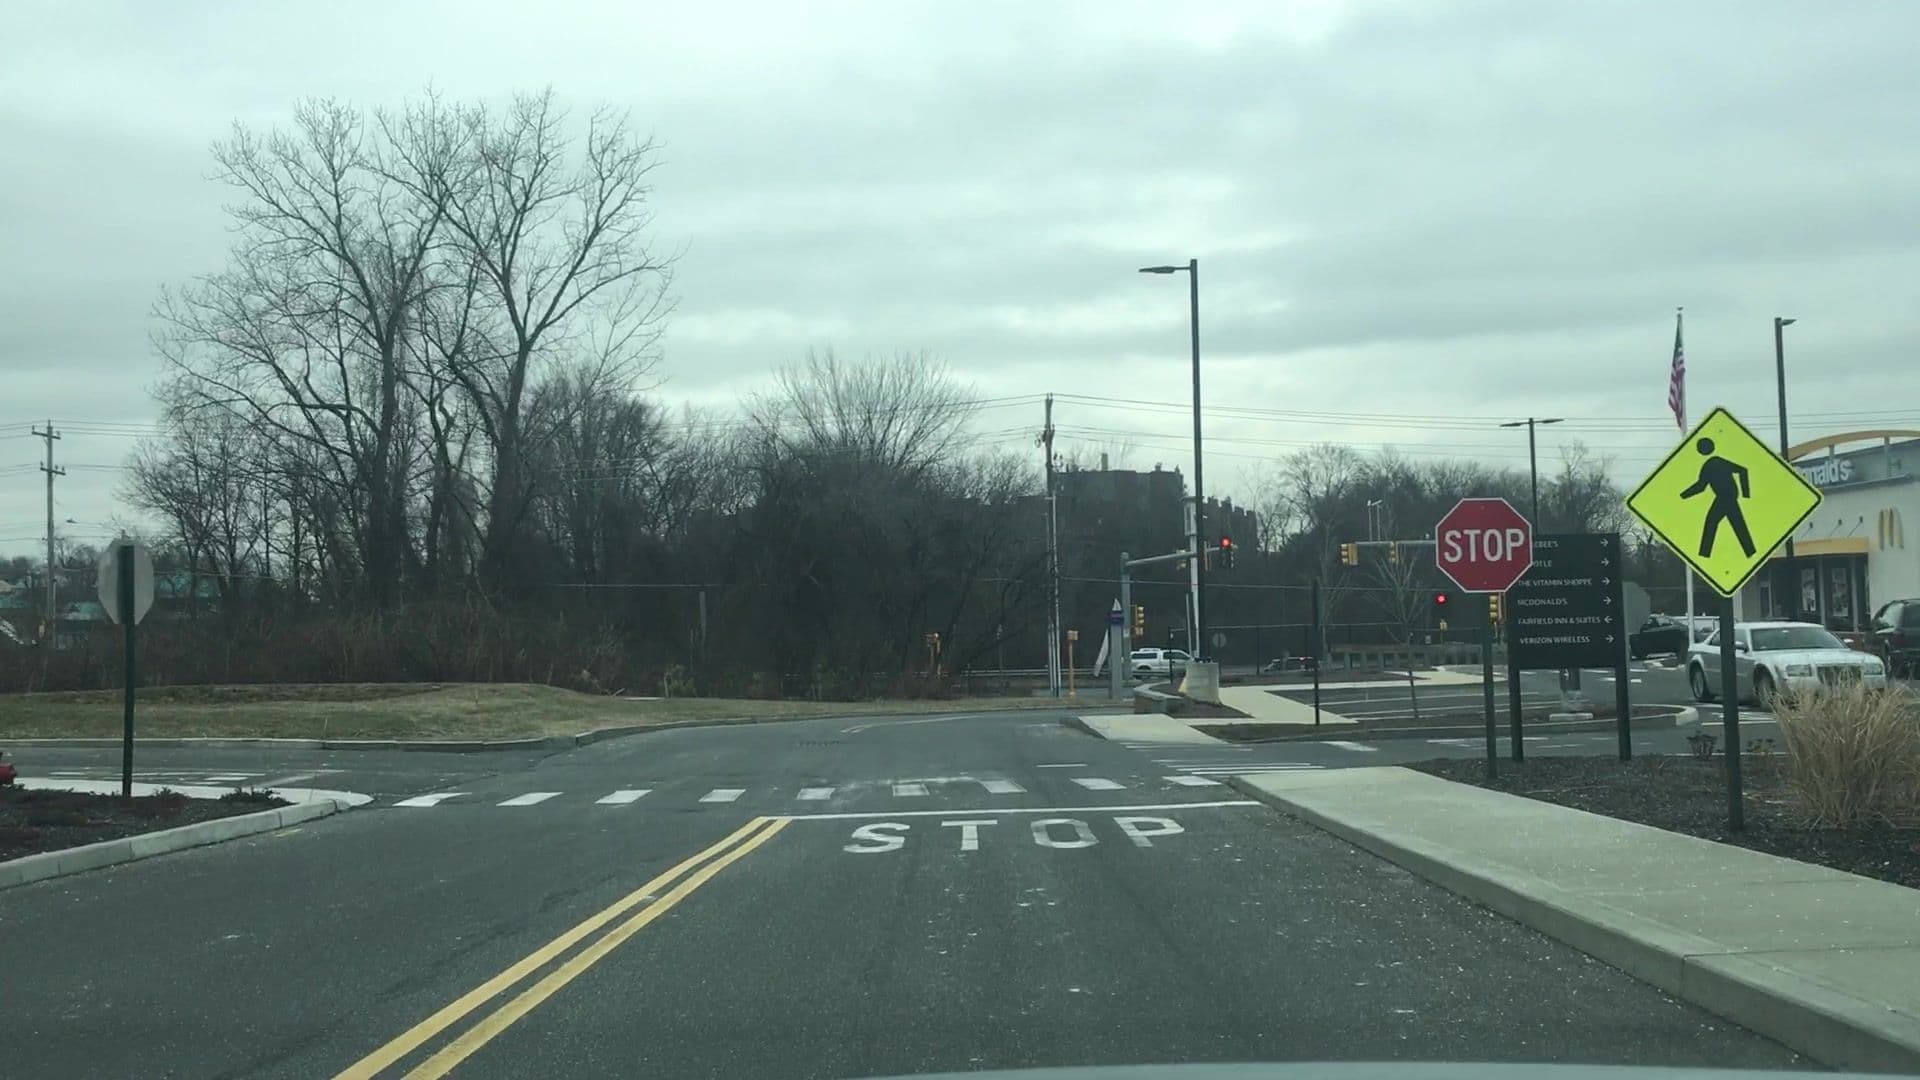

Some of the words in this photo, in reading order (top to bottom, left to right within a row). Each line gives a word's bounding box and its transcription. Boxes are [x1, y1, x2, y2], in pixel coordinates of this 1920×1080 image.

[1444, 528, 1525, 563] STOP
[1564, 578, 1592, 586] SHOPPE
[1518, 617, 1553, 625] FAIRFIELD
[1554, 616, 1568, 625] INN
[1569, 616, 1575, 624] &
[1575, 616, 1601, 624] SUITES
[1520, 636, 1553, 645] VERIZON
[1553, 635, 1591, 644] WIRELESS
[843, 816, 1185, 853] STOP
